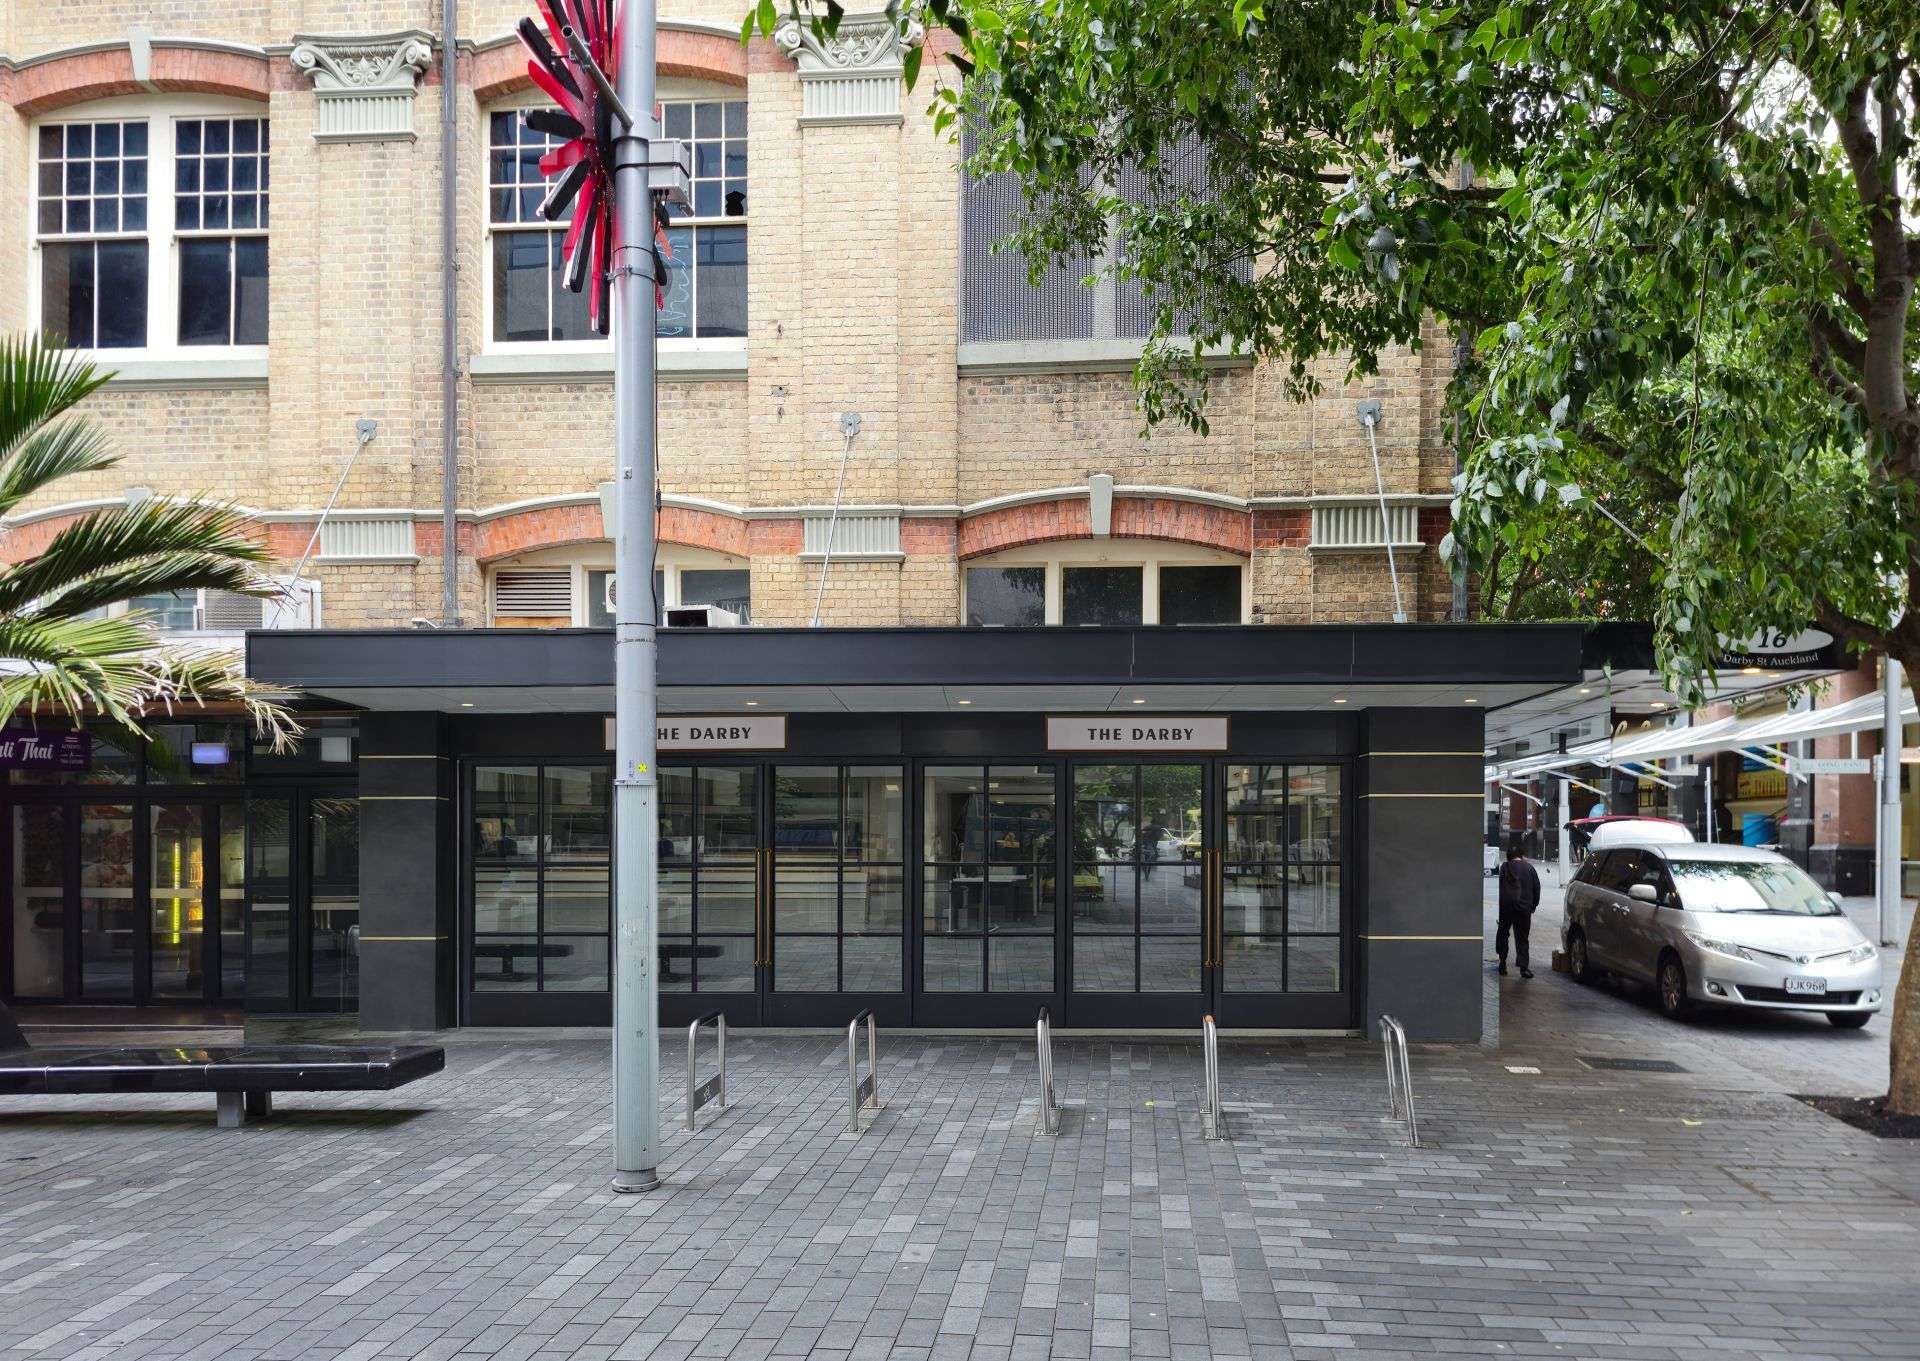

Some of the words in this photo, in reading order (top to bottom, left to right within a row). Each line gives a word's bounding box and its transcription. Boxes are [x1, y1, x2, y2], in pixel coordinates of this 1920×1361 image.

[1758, 629, 1787, 648] 16
[1723, 653, 1754, 667] Darby
[1756, 658, 1768, 666] St
[1771, 652, 1819, 666] Auckland
[658, 728, 679, 739] HE
[690, 728, 751, 740] DARBY
[1088, 728, 1122, 741] THE
[1132, 728, 1194, 741] DARBY
[17, 737, 54, 761] Thai
